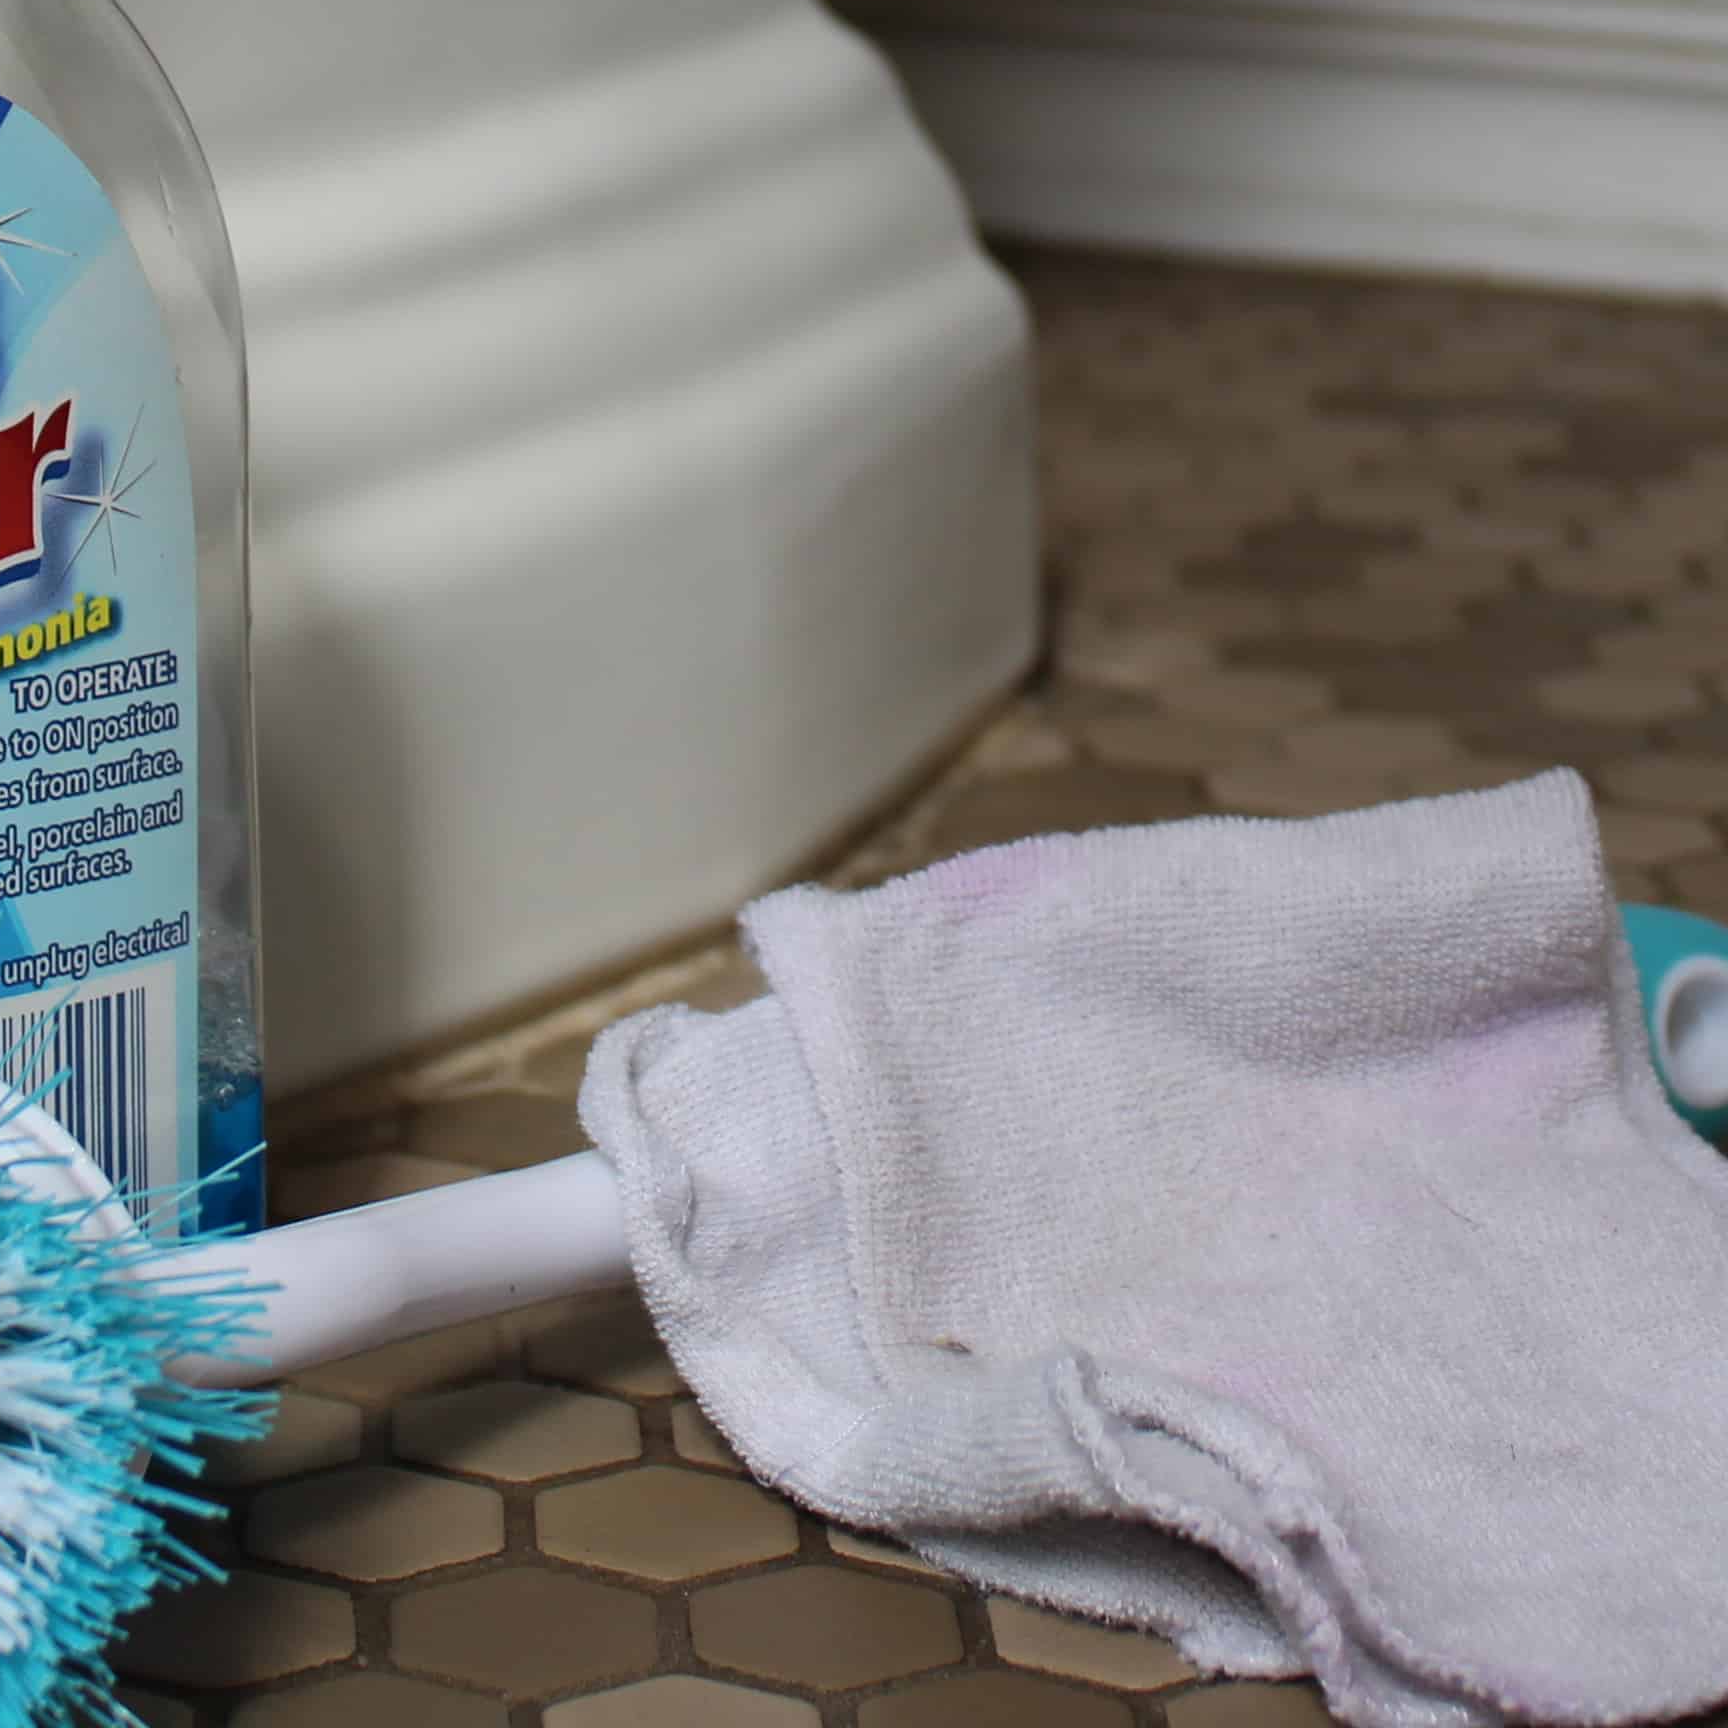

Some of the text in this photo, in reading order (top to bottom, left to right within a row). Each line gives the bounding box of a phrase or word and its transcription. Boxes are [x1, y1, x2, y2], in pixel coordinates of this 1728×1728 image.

[12, 653, 177, 712] TO OPERATE:
[11, 731, 38, 756] to
[44, 719, 82, 752] ON
[88, 703, 178, 751] position
[28, 770, 89, 802] from
[95, 750, 182, 790] surface.
[30, 806, 137, 859] porcelain
[142, 791, 182, 828] and
[28, 849, 132, 890] surfaces.
[3, 945, 89, 986] unplug
[94, 913, 189, 966] electrical
